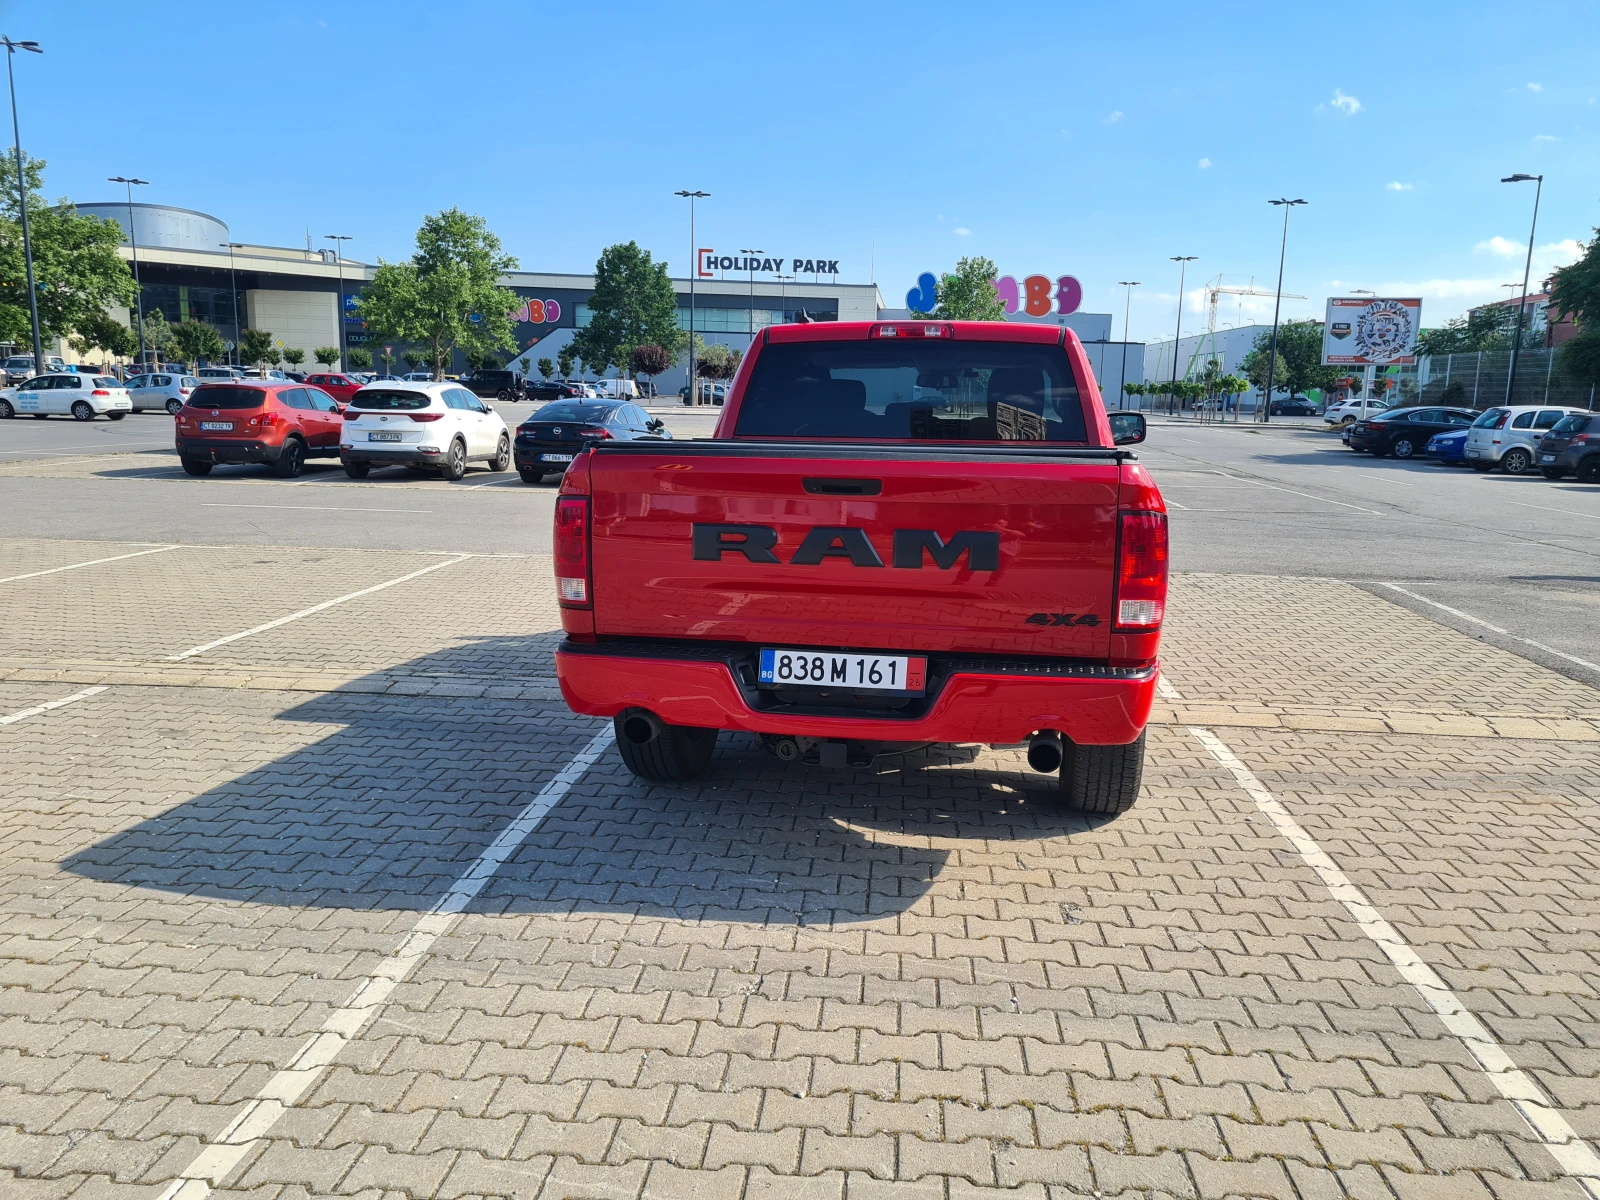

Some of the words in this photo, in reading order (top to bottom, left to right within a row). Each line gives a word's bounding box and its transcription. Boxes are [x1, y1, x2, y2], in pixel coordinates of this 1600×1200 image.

[706, 256, 784, 272] HOLIDAY
[793, 259, 839, 274] PARK
[905, 271, 1083, 318] JMBO
[692, 522, 999, 571] RAM
[1025, 613, 1102, 626] 4X4
[761, 670, 773, 678] BG
[778, 655, 824, 682] 838
[830, 657, 847, 683] M
[856, 659, 897, 685] 161
[909, 678, 920, 687] 26
